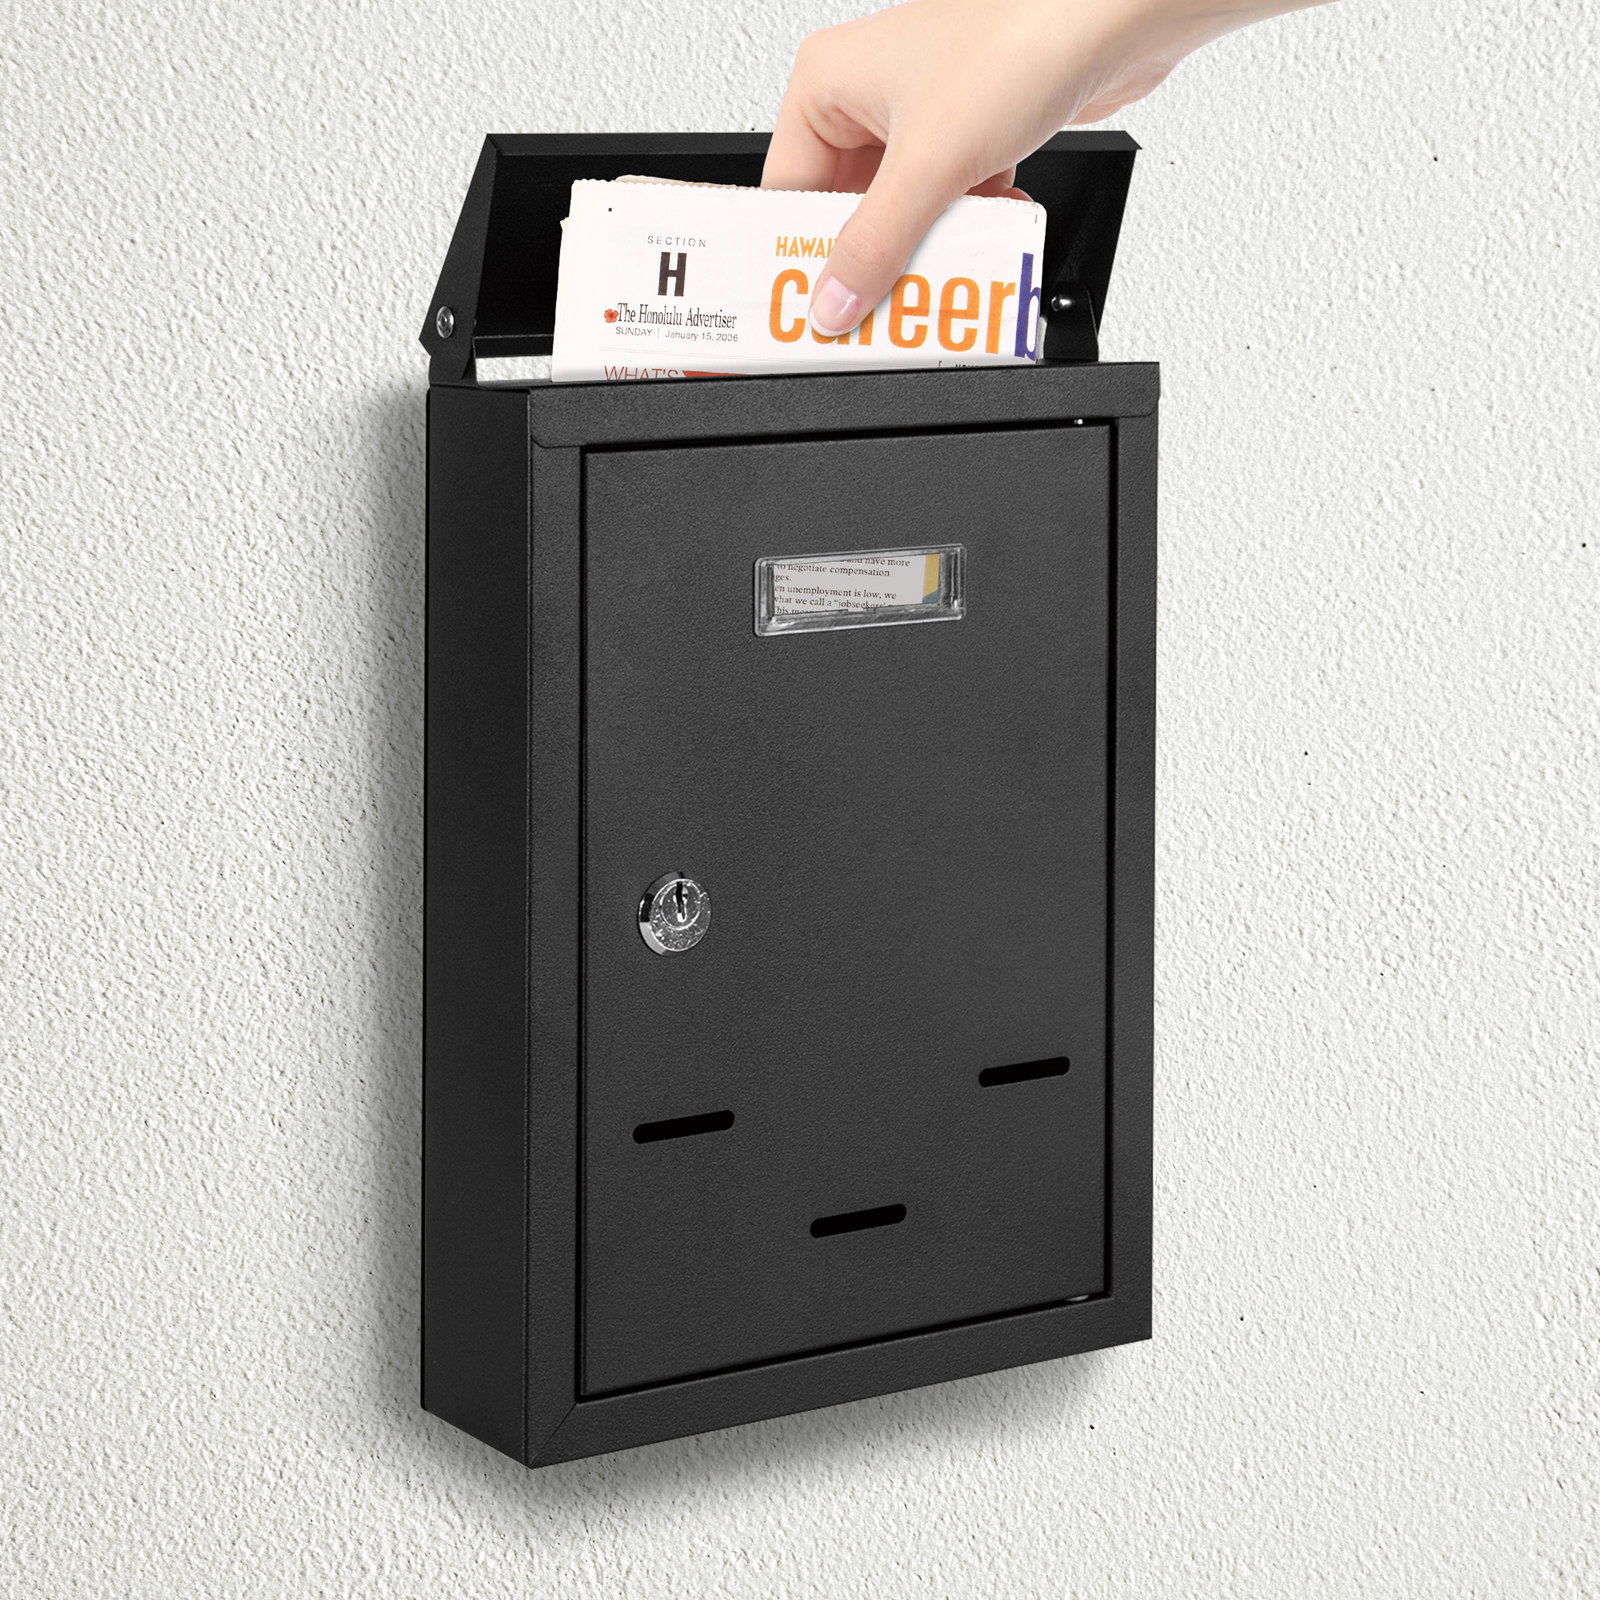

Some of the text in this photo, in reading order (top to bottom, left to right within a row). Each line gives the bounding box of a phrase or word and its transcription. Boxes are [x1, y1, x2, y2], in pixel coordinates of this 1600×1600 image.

[647, 235, 707, 248] SECTION
[776, 235, 838, 259] HAWAI
[657, 251, 688, 297] H
[618, 302, 738, 329] The Honolulu Advertiser
[615, 326, 653, 337] SUNDAY
[665, 330, 699, 341] January
[702, 332, 714, 341] 15,
[788, 563, 828, 573] negotiate
[829, 566, 890, 577] compensation
[887, 559, 911, 567] more
[787, 585, 852, 598] unemployment
[854, 588, 862, 597] is
[863, 588, 882, 599] low,
[884, 592, 897, 600] we
[809, 597, 825, 606] call
